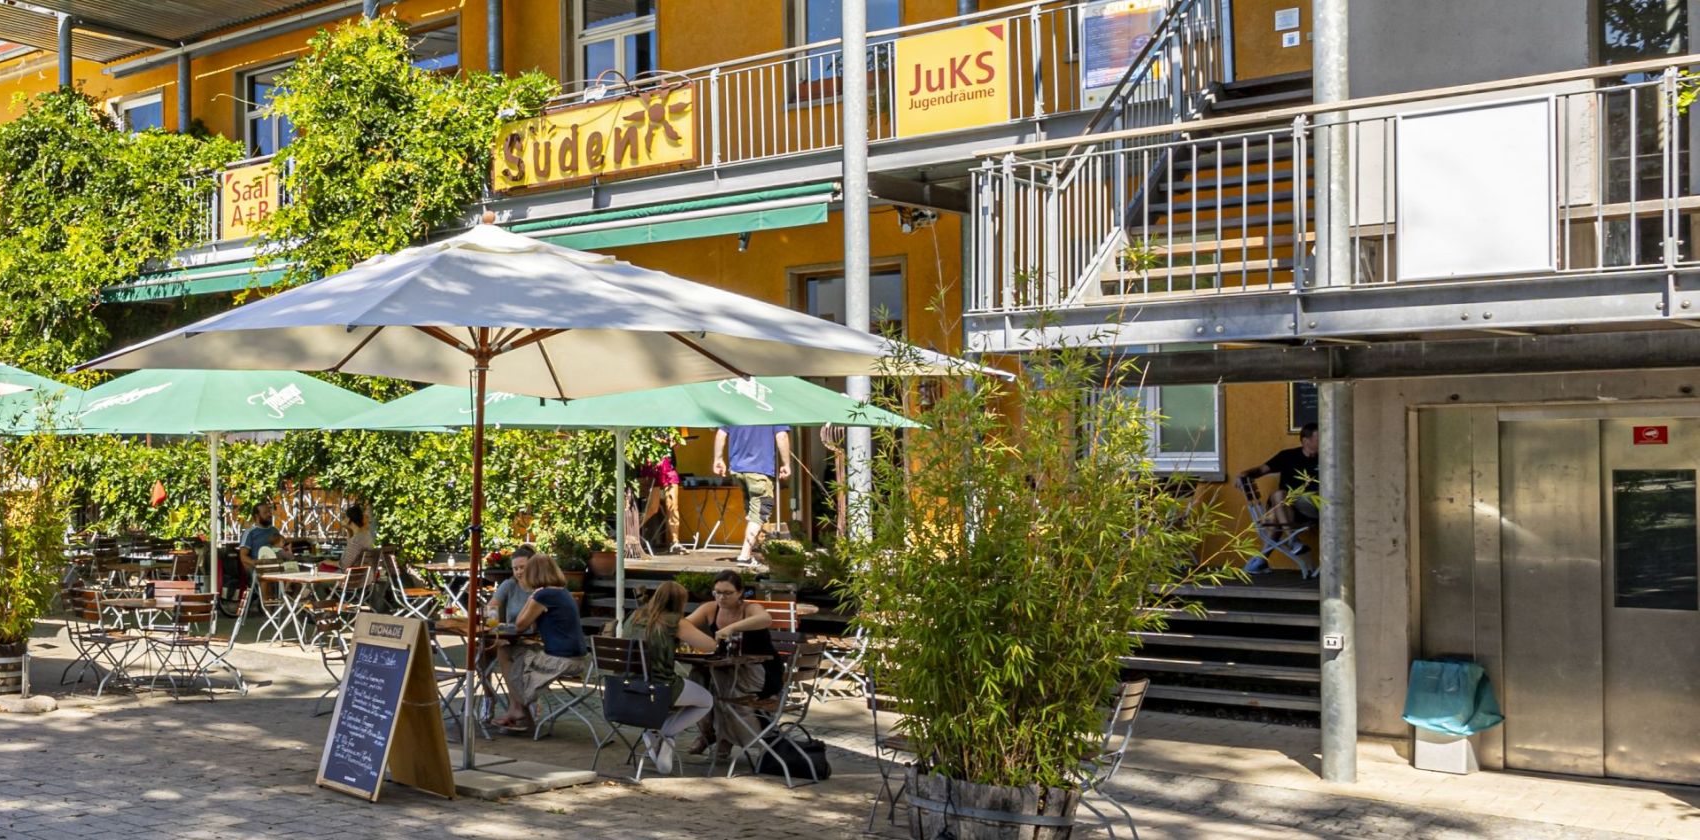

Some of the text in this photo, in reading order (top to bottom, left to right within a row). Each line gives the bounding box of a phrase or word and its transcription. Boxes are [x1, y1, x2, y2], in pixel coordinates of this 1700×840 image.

[909, 51, 996, 96] JuKS
[908, 87, 996, 111] Jugendräume
[502, 123, 640, 183] Süden
[231, 173, 270, 203] Saal
[370, 624, 403, 638] BIONADE
